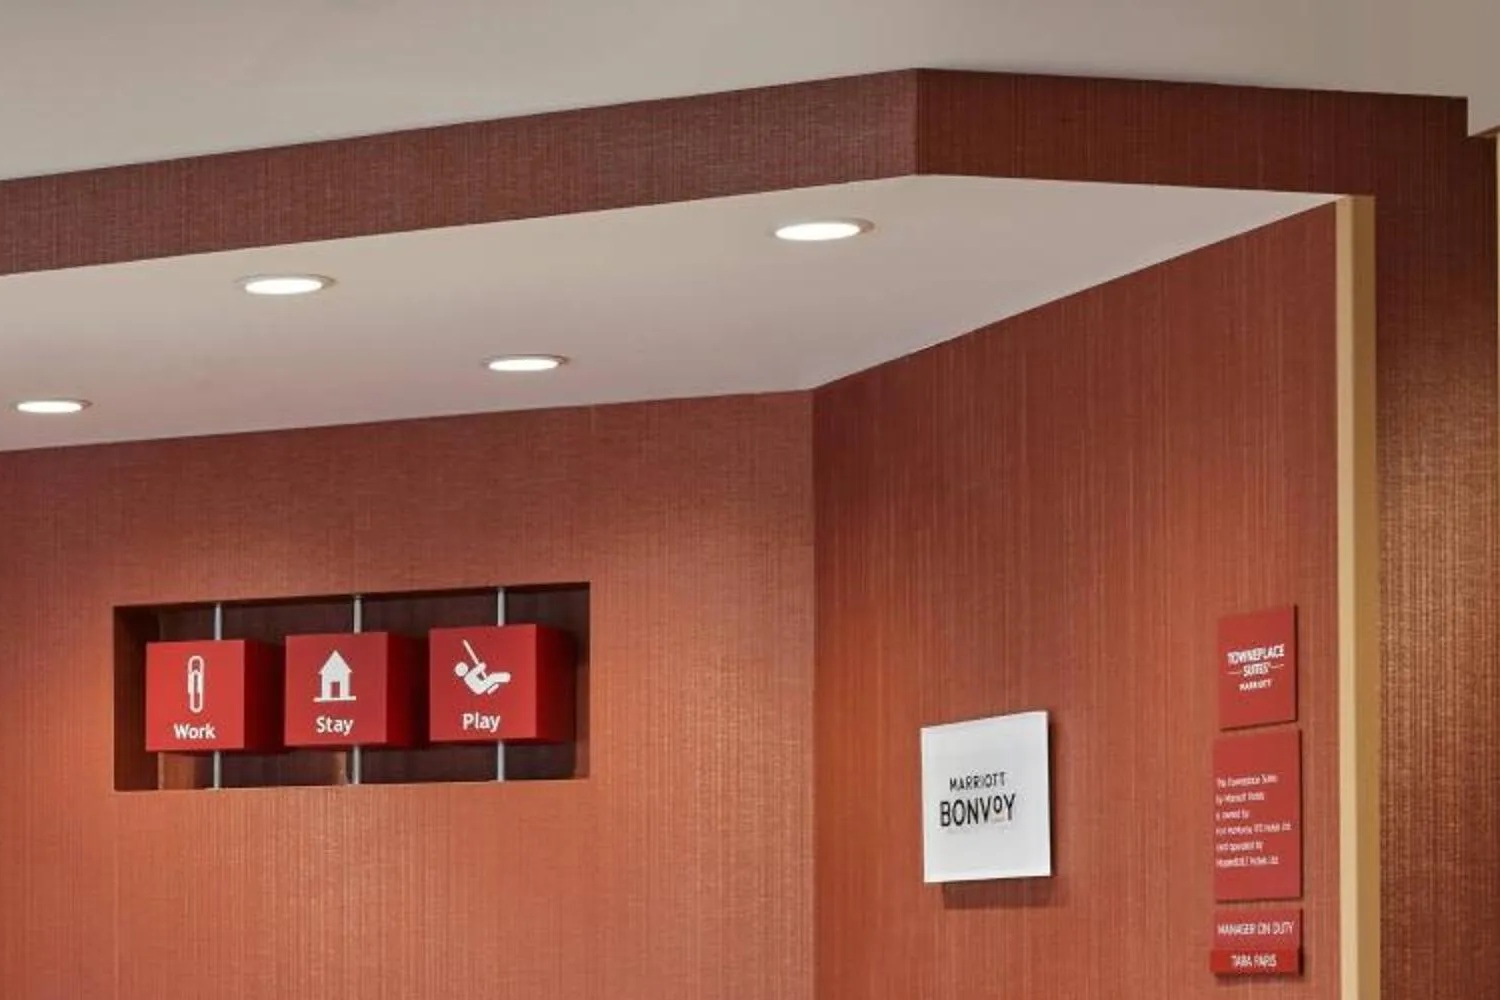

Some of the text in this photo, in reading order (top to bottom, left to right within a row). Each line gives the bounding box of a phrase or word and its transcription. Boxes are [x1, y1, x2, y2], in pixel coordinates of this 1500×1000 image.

[174, 723, 216, 740] Work
[316, 716, 354, 736] Stay
[463, 713, 501, 733] Play
[950, 772, 1006, 791] MARRIOTT
[940, 794, 1015, 827] BONVOY
[1217, 920, 1294, 935] MANAGER ON DUTY
